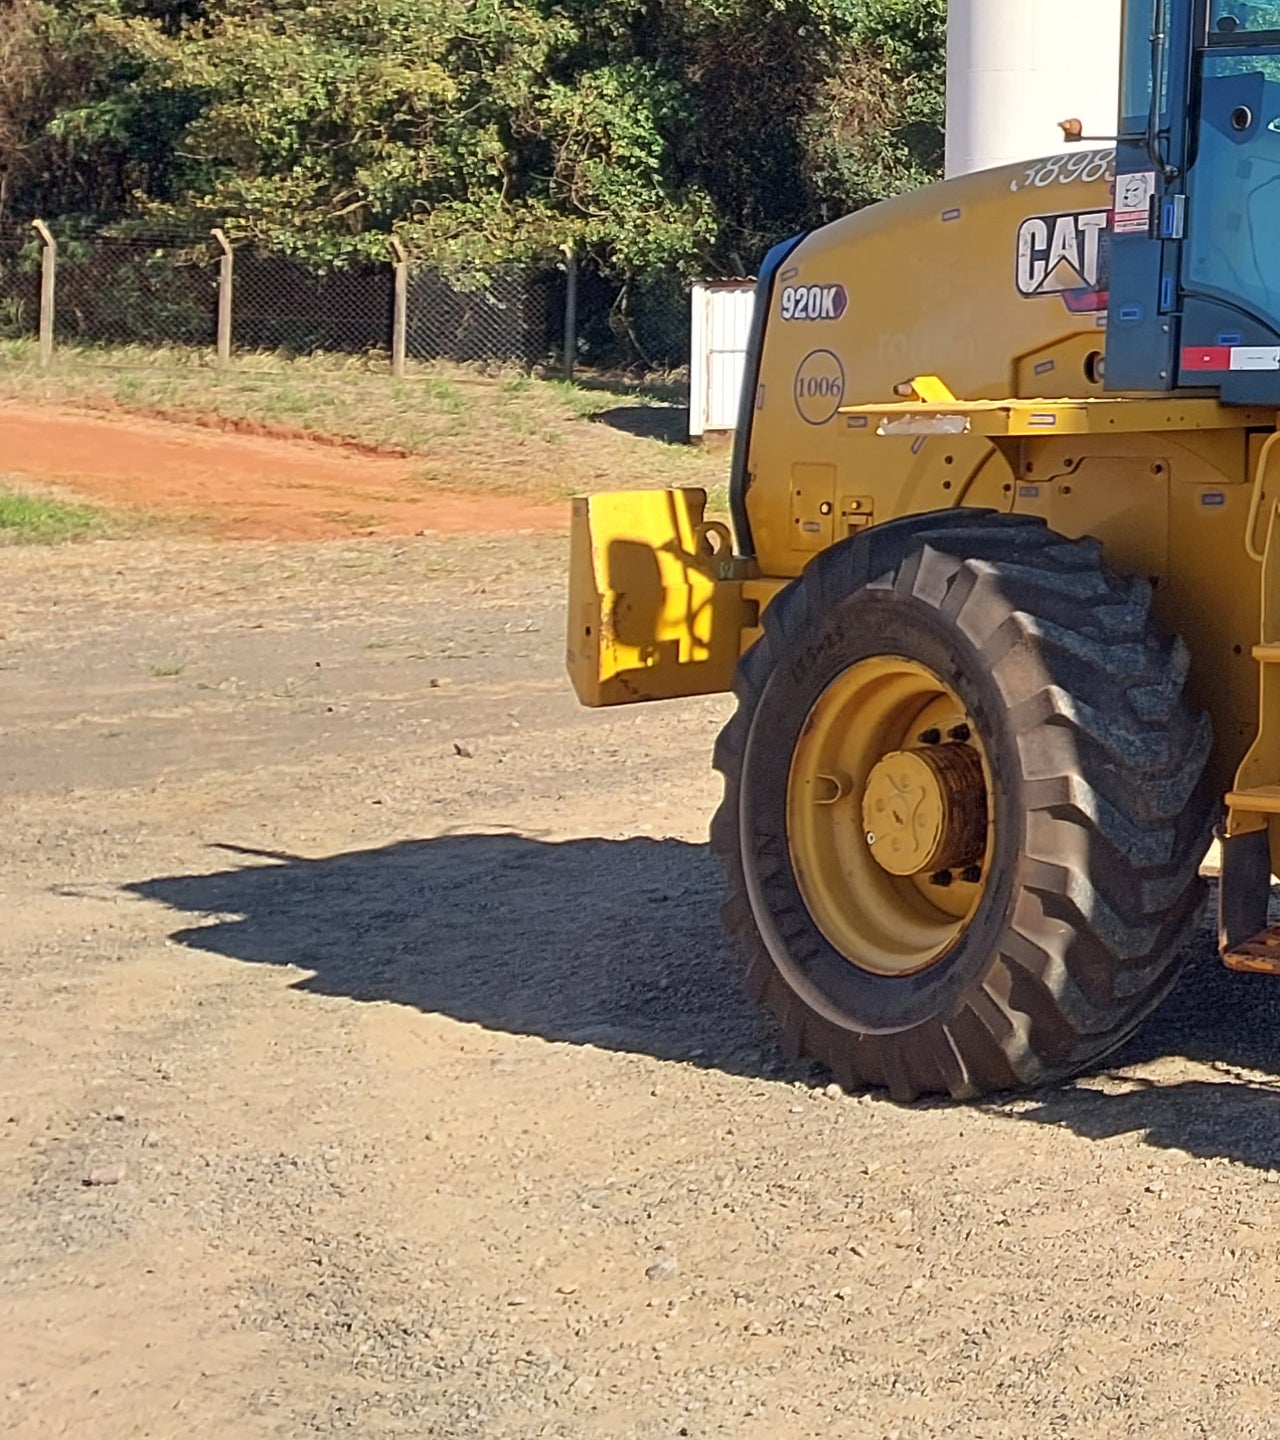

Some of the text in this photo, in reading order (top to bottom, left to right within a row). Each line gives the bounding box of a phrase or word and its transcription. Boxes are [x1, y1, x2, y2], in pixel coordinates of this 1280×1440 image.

[1017, 212, 1107, 294] CAT
[782, 286, 837, 320] 920K
[797, 376, 841, 398] 1006
